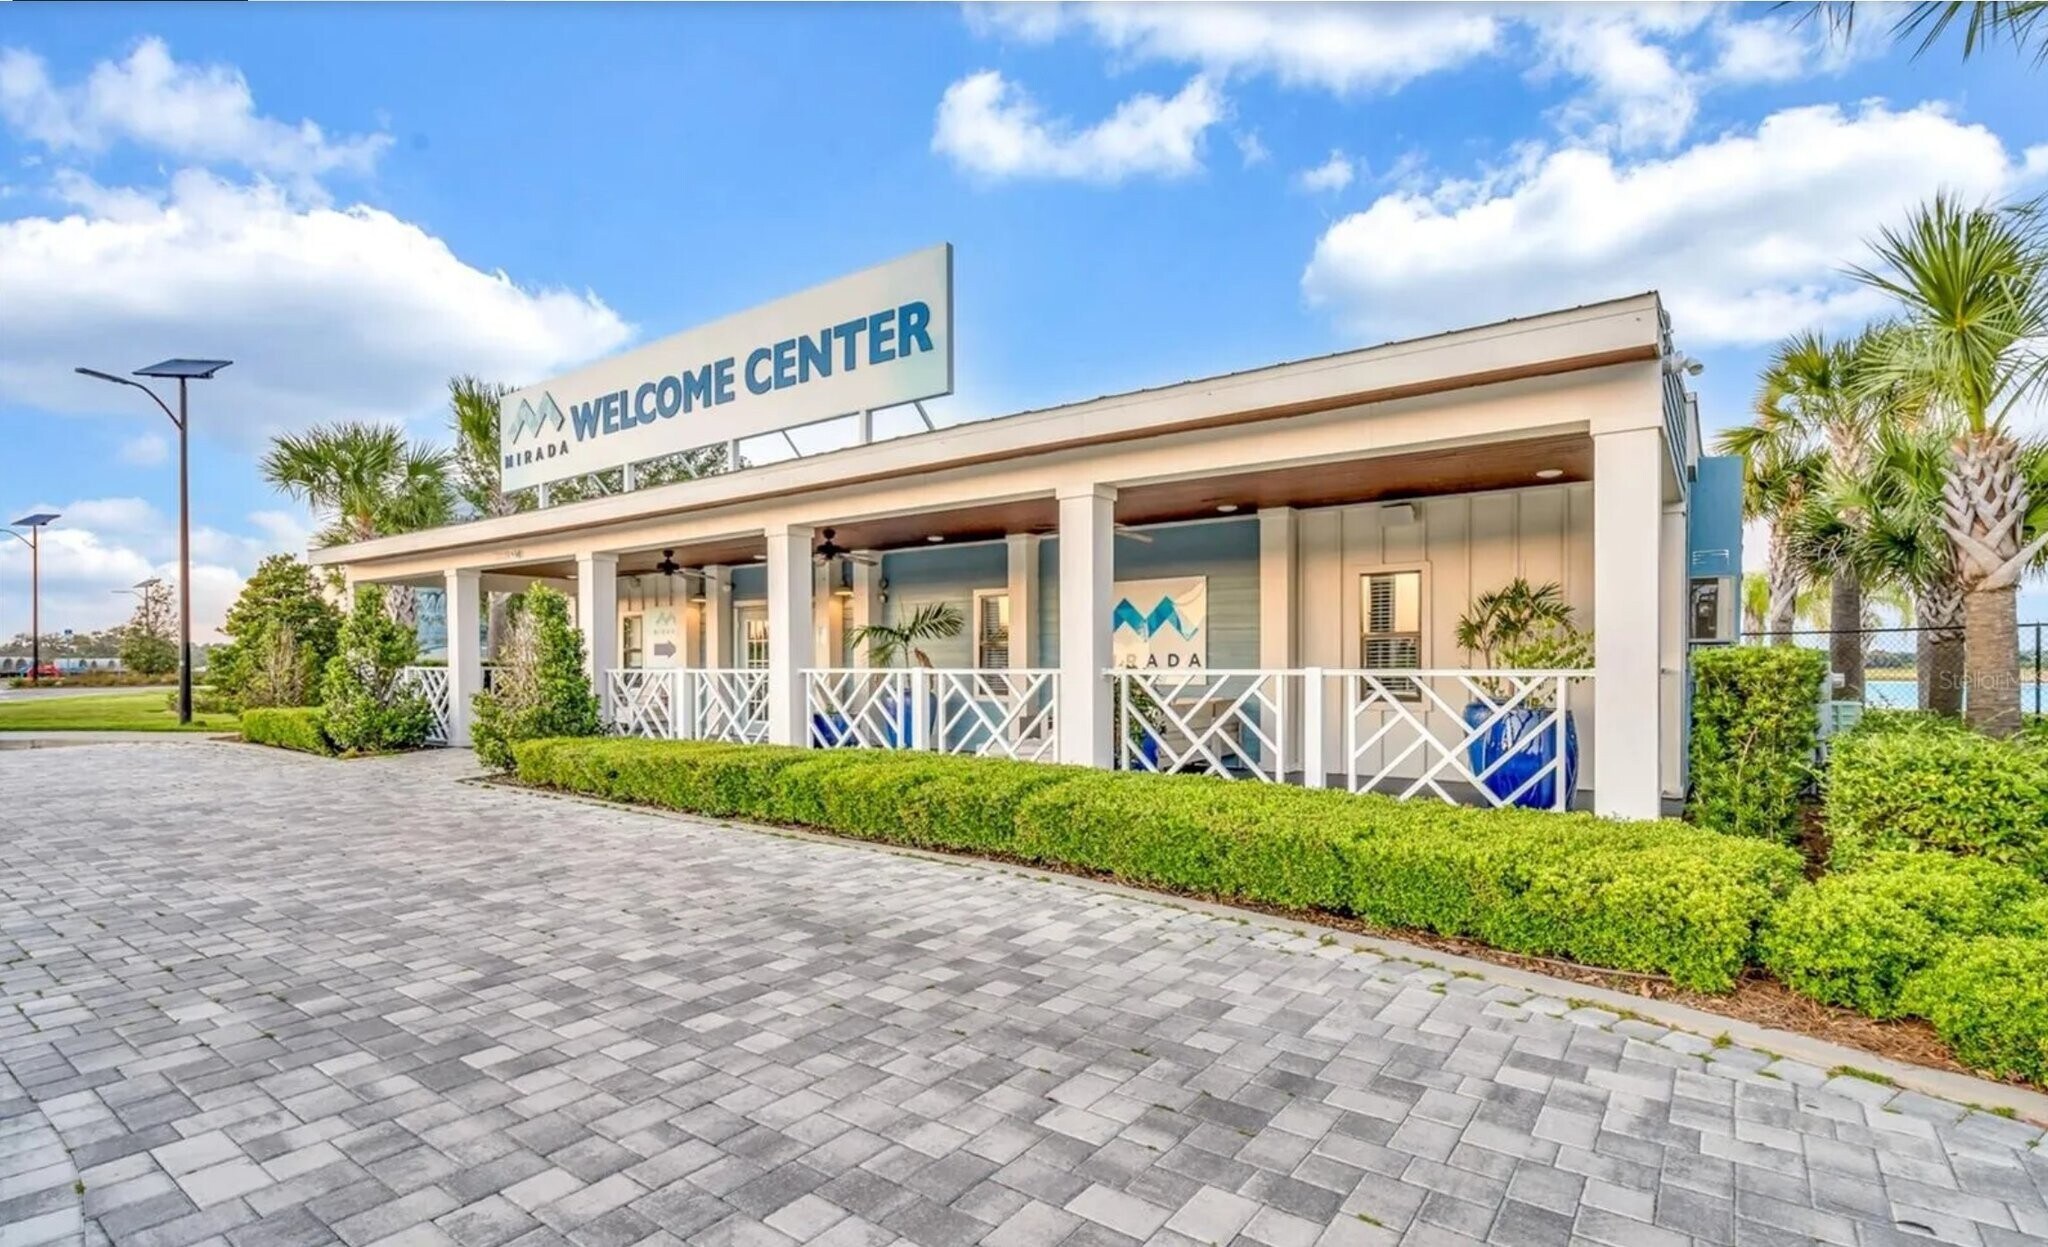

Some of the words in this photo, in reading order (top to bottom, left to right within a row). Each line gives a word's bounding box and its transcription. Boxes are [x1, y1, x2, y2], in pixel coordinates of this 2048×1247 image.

[570, 357, 735, 442] WELCOME
[745, 301, 933, 395] CENTER
[505, 440, 569, 469] MIRADA
[1117, 653, 1202, 669] RADA
